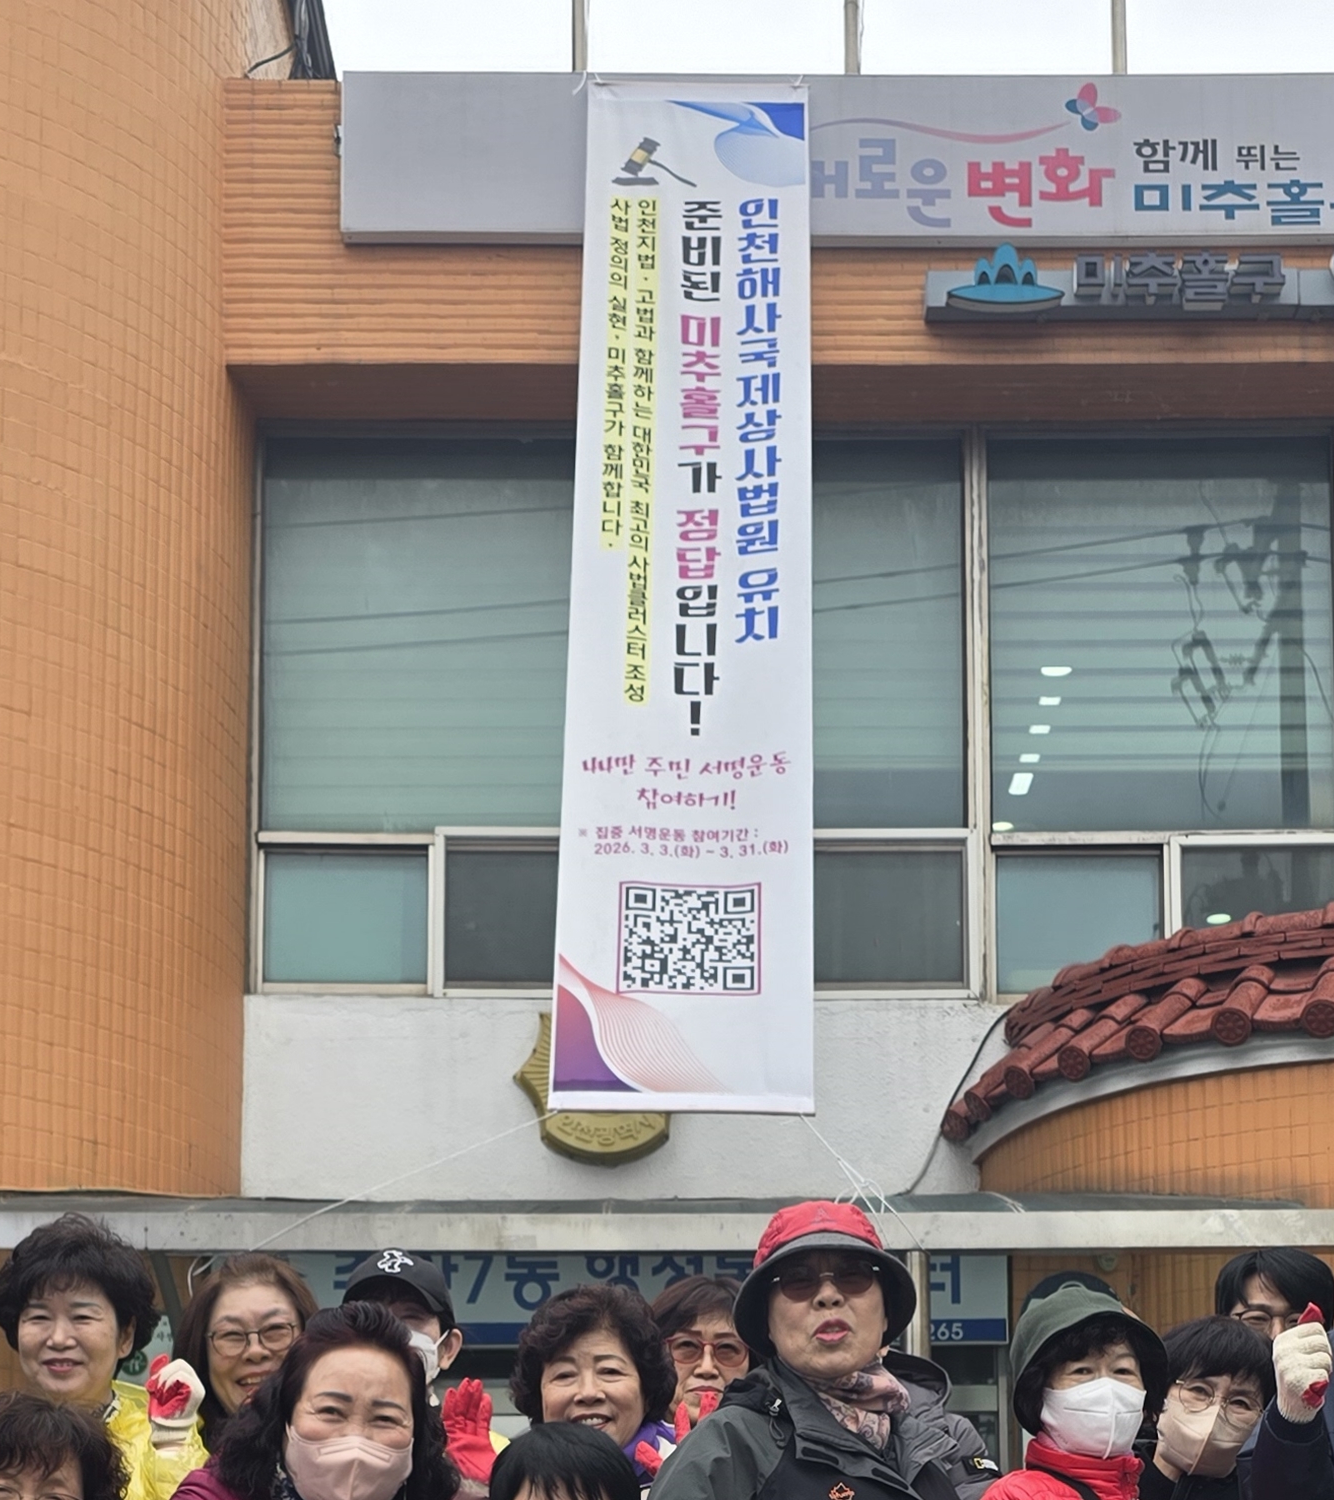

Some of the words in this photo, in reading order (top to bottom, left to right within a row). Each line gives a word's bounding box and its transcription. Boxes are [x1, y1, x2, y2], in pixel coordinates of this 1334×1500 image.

[967, 147, 1115, 228] 변화
[1132, 137, 1218, 174] 함께
[1235, 144, 1301, 172] 뛰는
[610, 198, 631, 234] 사법
[608, 237, 629, 291] 정의의
[680, 200, 723, 302] 준비된
[1074, 248, 1286, 308] 미추홀구
[603, 347, 626, 437] 미추홀구가
[632, 348, 655, 420] 함께하는
[677, 314, 723, 494] 미추홀구가
[735, 198, 782, 556] 인천해사국제상사법원
[631, 425, 653, 495] 대한민국
[601, 444, 625, 548] 함께합니다.
[628, 500, 650, 553] 최고의
[673, 508, 722, 736] 정답입니다!
[735, 567, 780, 644] 유치
[624, 663, 647, 703] 조성
[643, 755, 692, 780] 주민
[699, 751, 792, 780] 서명운동
[636, 787, 737, 810] 참여하기!
[594, 842, 636, 856] 2026.
[595, 826, 623, 840] 집중
[628, 825, 687, 842] 서명운동
